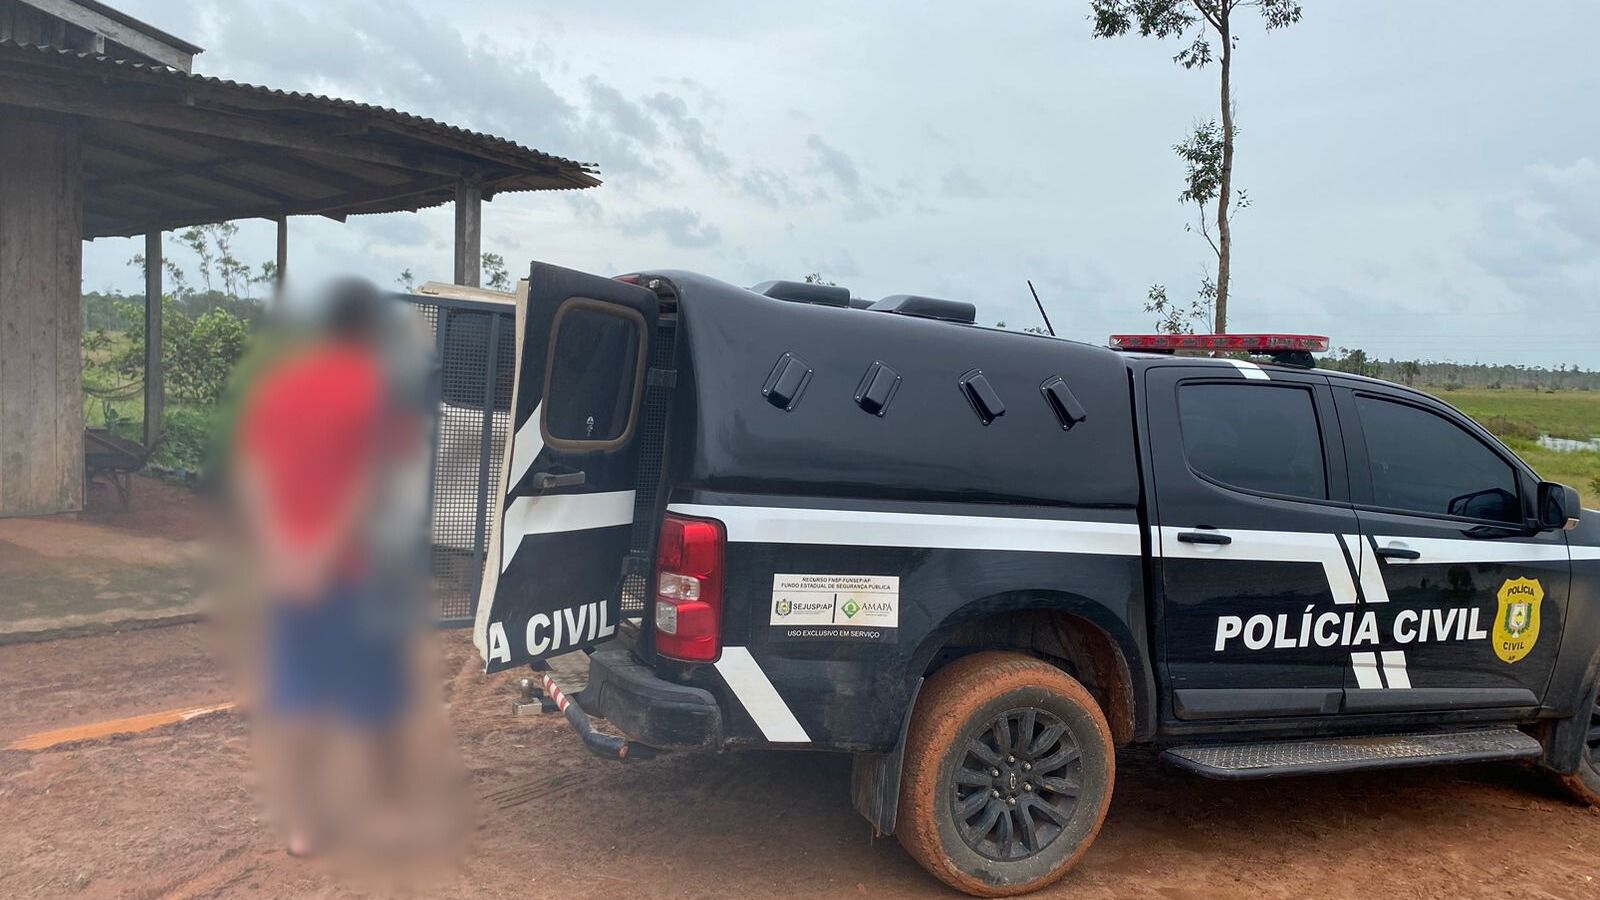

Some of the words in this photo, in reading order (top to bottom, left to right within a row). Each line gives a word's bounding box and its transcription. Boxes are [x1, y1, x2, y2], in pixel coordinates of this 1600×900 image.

[1507, 584, 1535, 597] POLÍCIA
[793, 603, 832, 611] SEJUSP/AP
[861, 602, 893, 612] AMAPÁ
[489, 621, 512, 663] A
[526, 600, 615, 656] CIVIL
[1214, 604, 1380, 652] POLÍCIA
[1393, 607, 1488, 644] CIVIL
[850, 630, 880, 639] SERVIÇO
[1503, 641, 1525, 650] CIVIL
